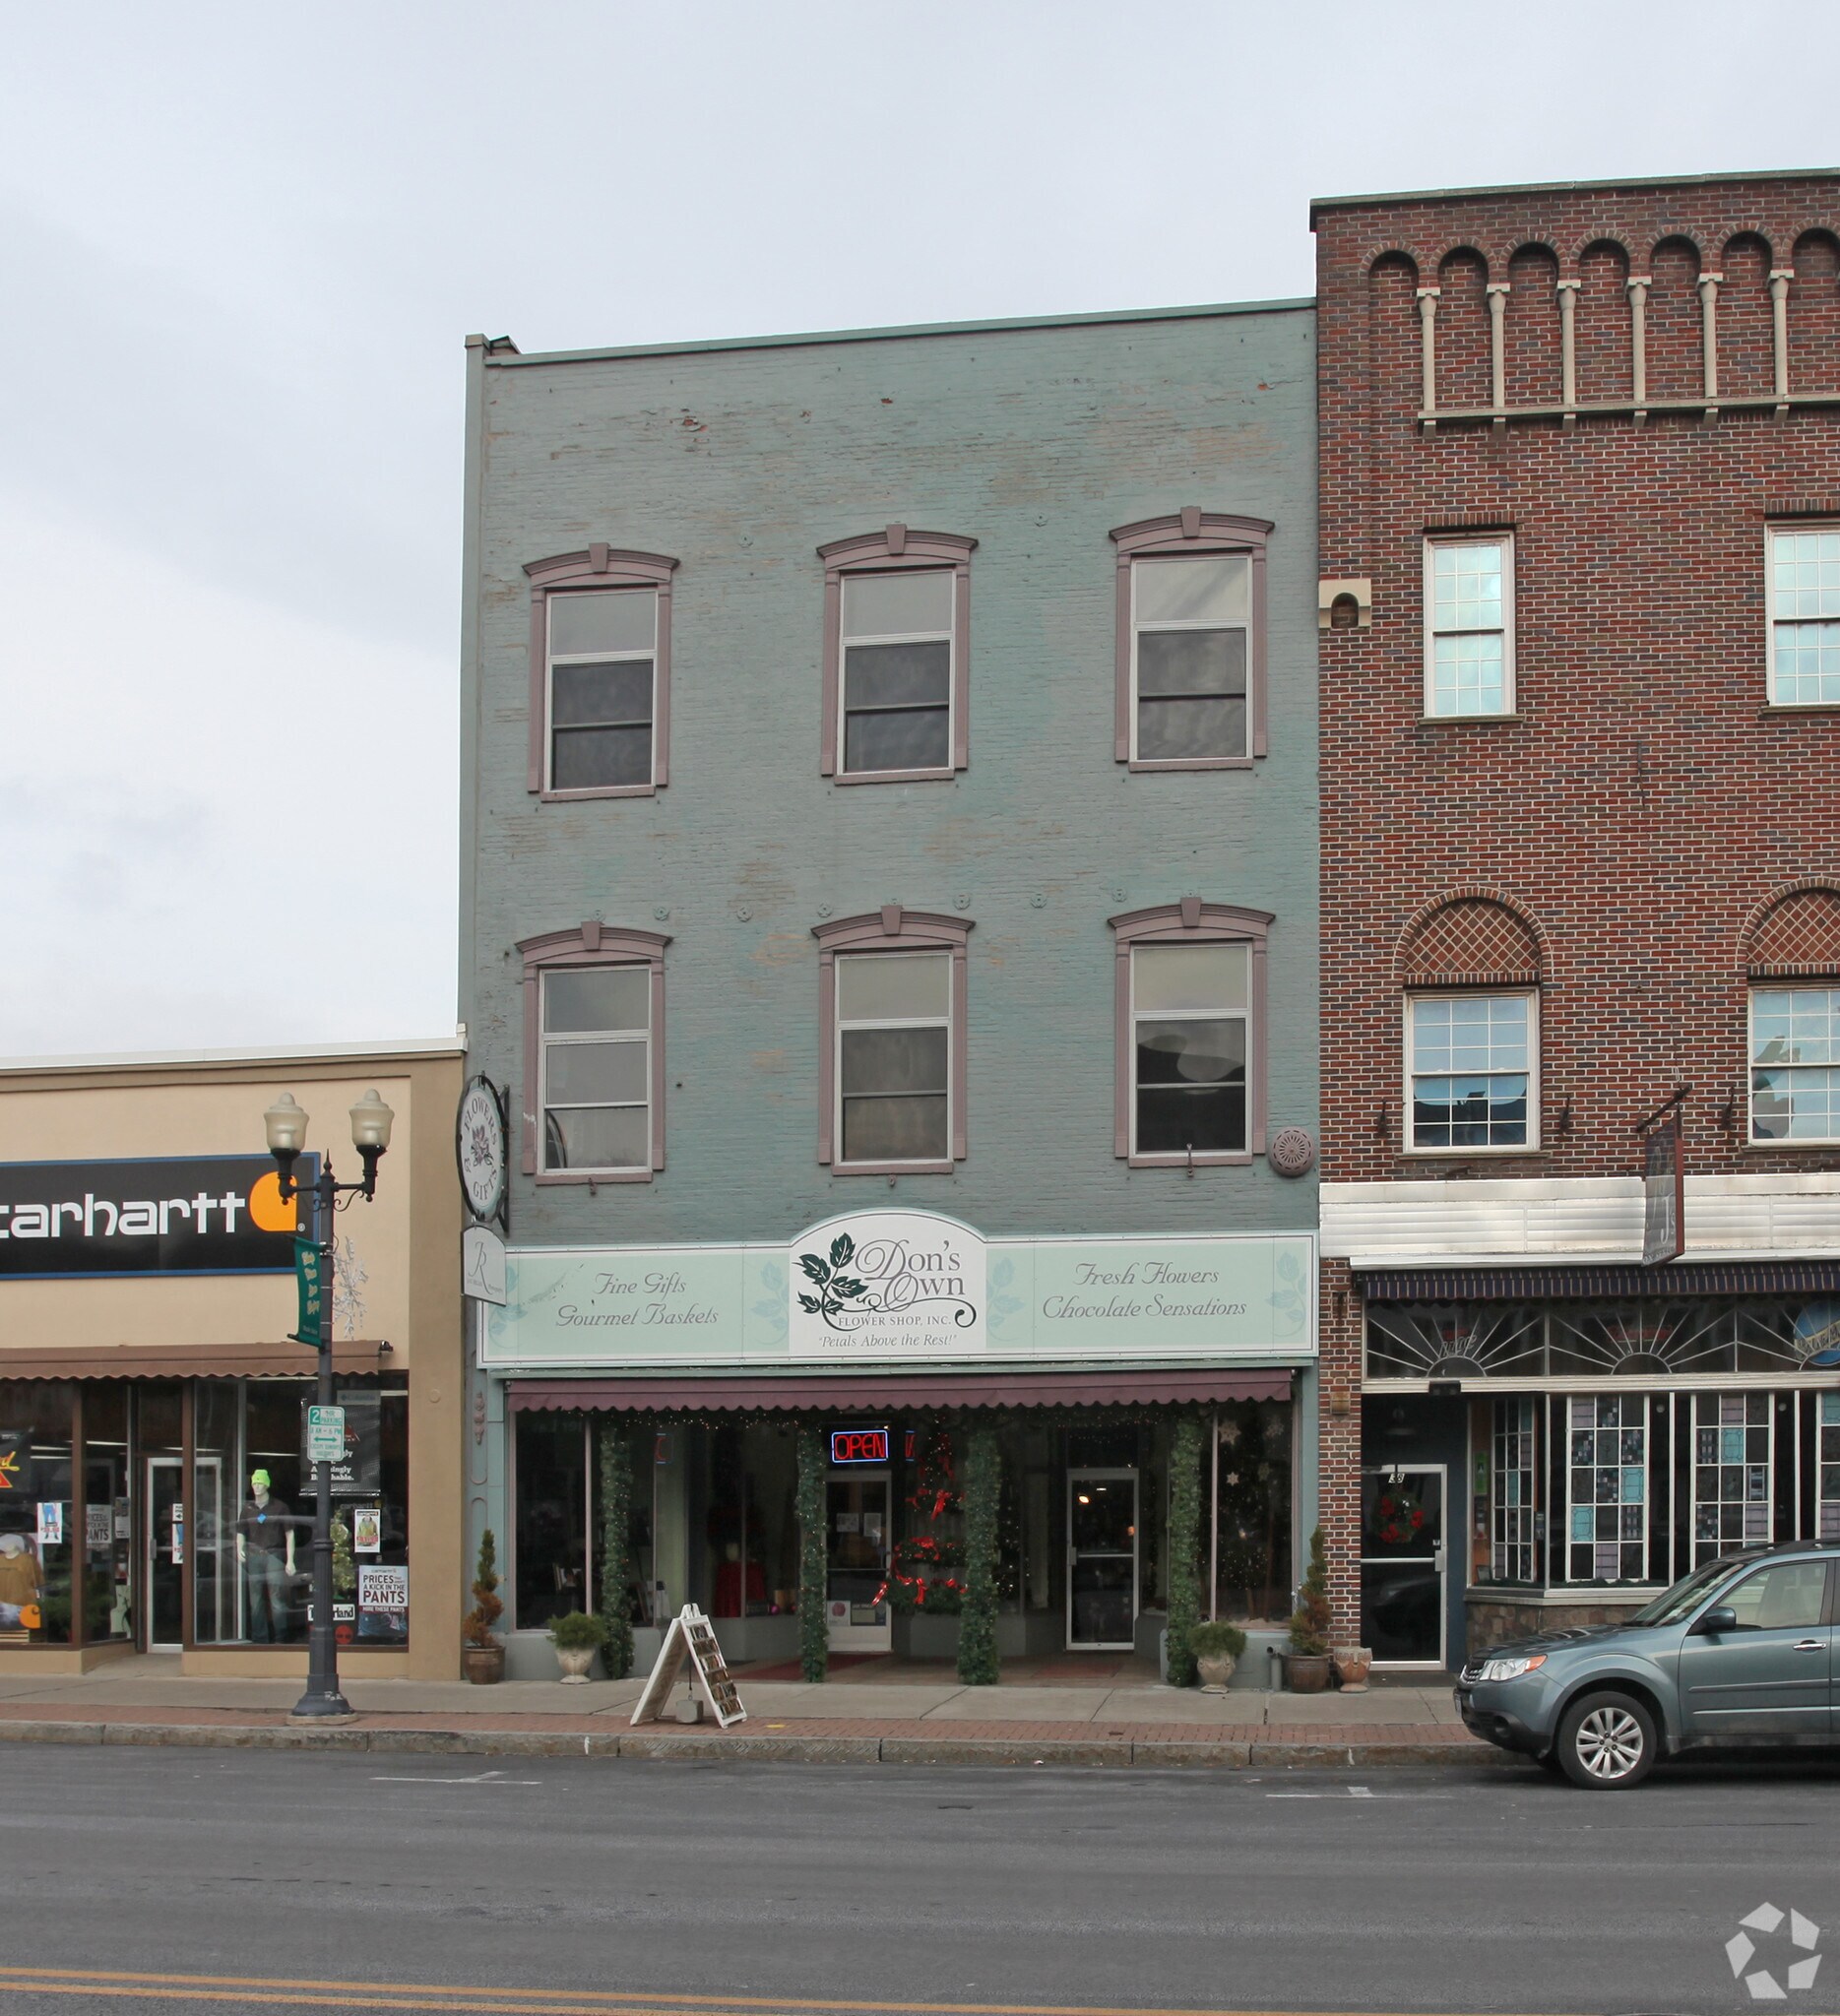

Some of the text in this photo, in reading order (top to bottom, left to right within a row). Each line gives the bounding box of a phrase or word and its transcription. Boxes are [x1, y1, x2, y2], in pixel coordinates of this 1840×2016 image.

[0, 1191, 245, 1238] arhartt
[855, 1238, 962, 1281] Don's
[1075, 1260, 1220, 1286] Fresh Flowers
[594, 1272, 687, 1301] Fine Gifts
[883, 1271, 966, 1312] Own
[554, 1302, 720, 1328] Gourmet Baskets
[1042, 1292, 1247, 1320] Chocolate Sensations
[838, 1316, 952, 1327] FLOWER SHOP, INC.
[860, 1334, 897, 1347] Above
[901, 1334, 920, 1347] the
[312, 1409, 320, 1423] 2
[834, 1433, 885, 1459] OPEN
[88, 1528, 109, 1542] ANTS
[362, 1574, 394, 1584] PRICES
[363, 1590, 405, 1605] PANTS
